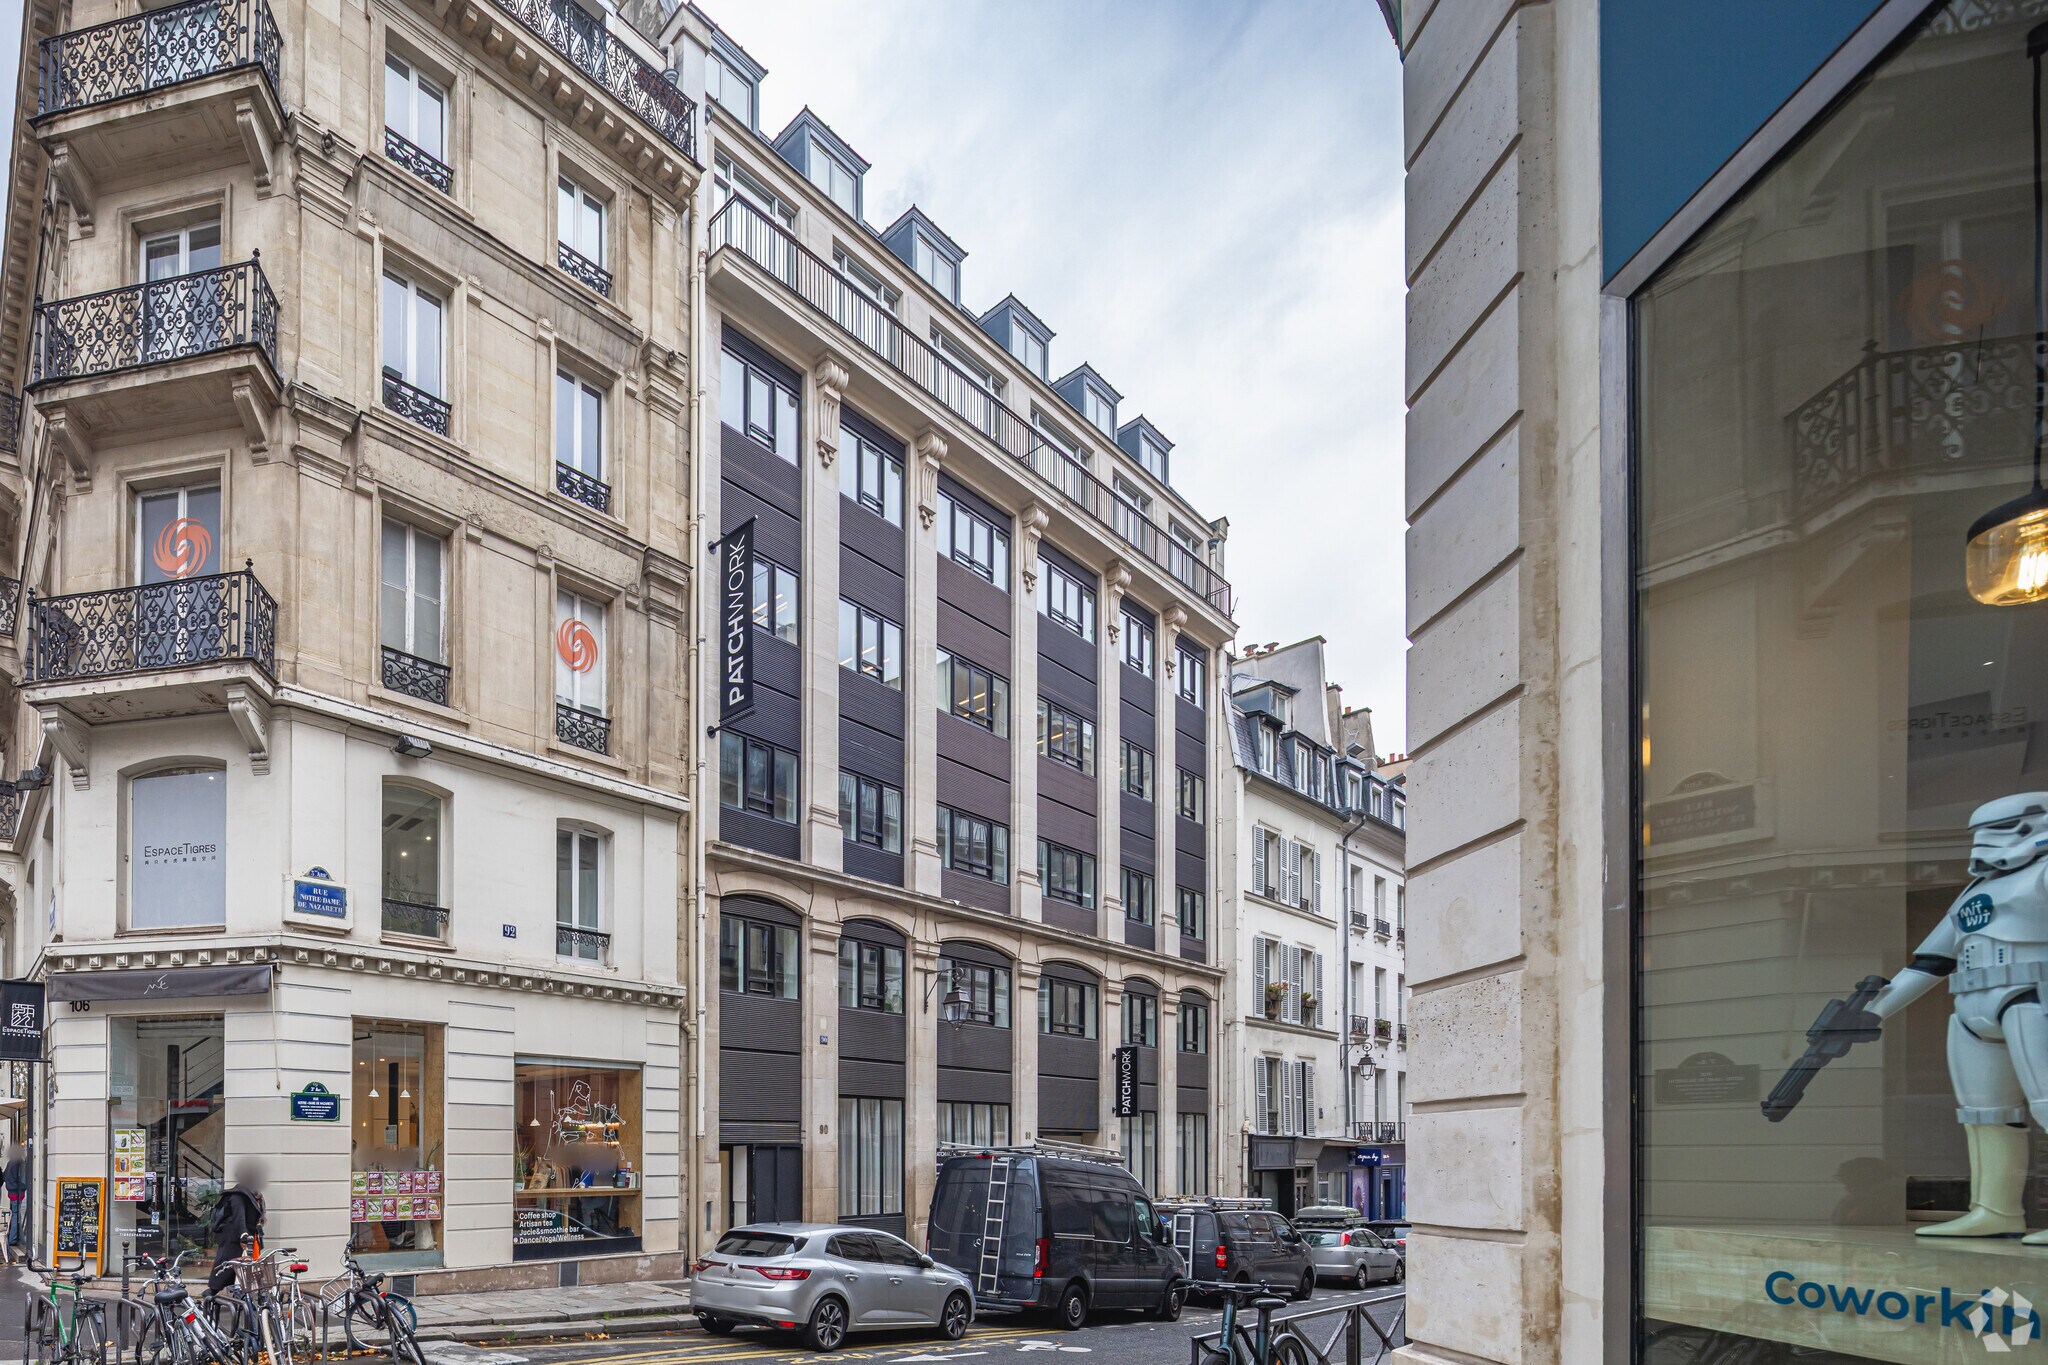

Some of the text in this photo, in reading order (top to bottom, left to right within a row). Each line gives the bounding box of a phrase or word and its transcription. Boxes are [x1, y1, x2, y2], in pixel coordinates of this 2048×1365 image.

[727, 534, 746, 706] PATCHWORK
[313, 888, 329, 897] RUE
[300, 894, 341, 906] NOTRE DAME
[309, 903, 343, 914] NAZARETH
[504, 925, 515, 937] 92
[69, 1000, 91, 1012] 106
[1122, 1050, 1131, 1114] PATCHWORK
[819, 1124, 829, 1135] 90
[519, 1211, 556, 1220] Coffee shop
[519, 1227, 568, 1236] Jucie&smoothie
[519, 1234, 584, 1244] Dance/Yoga/Wellness
